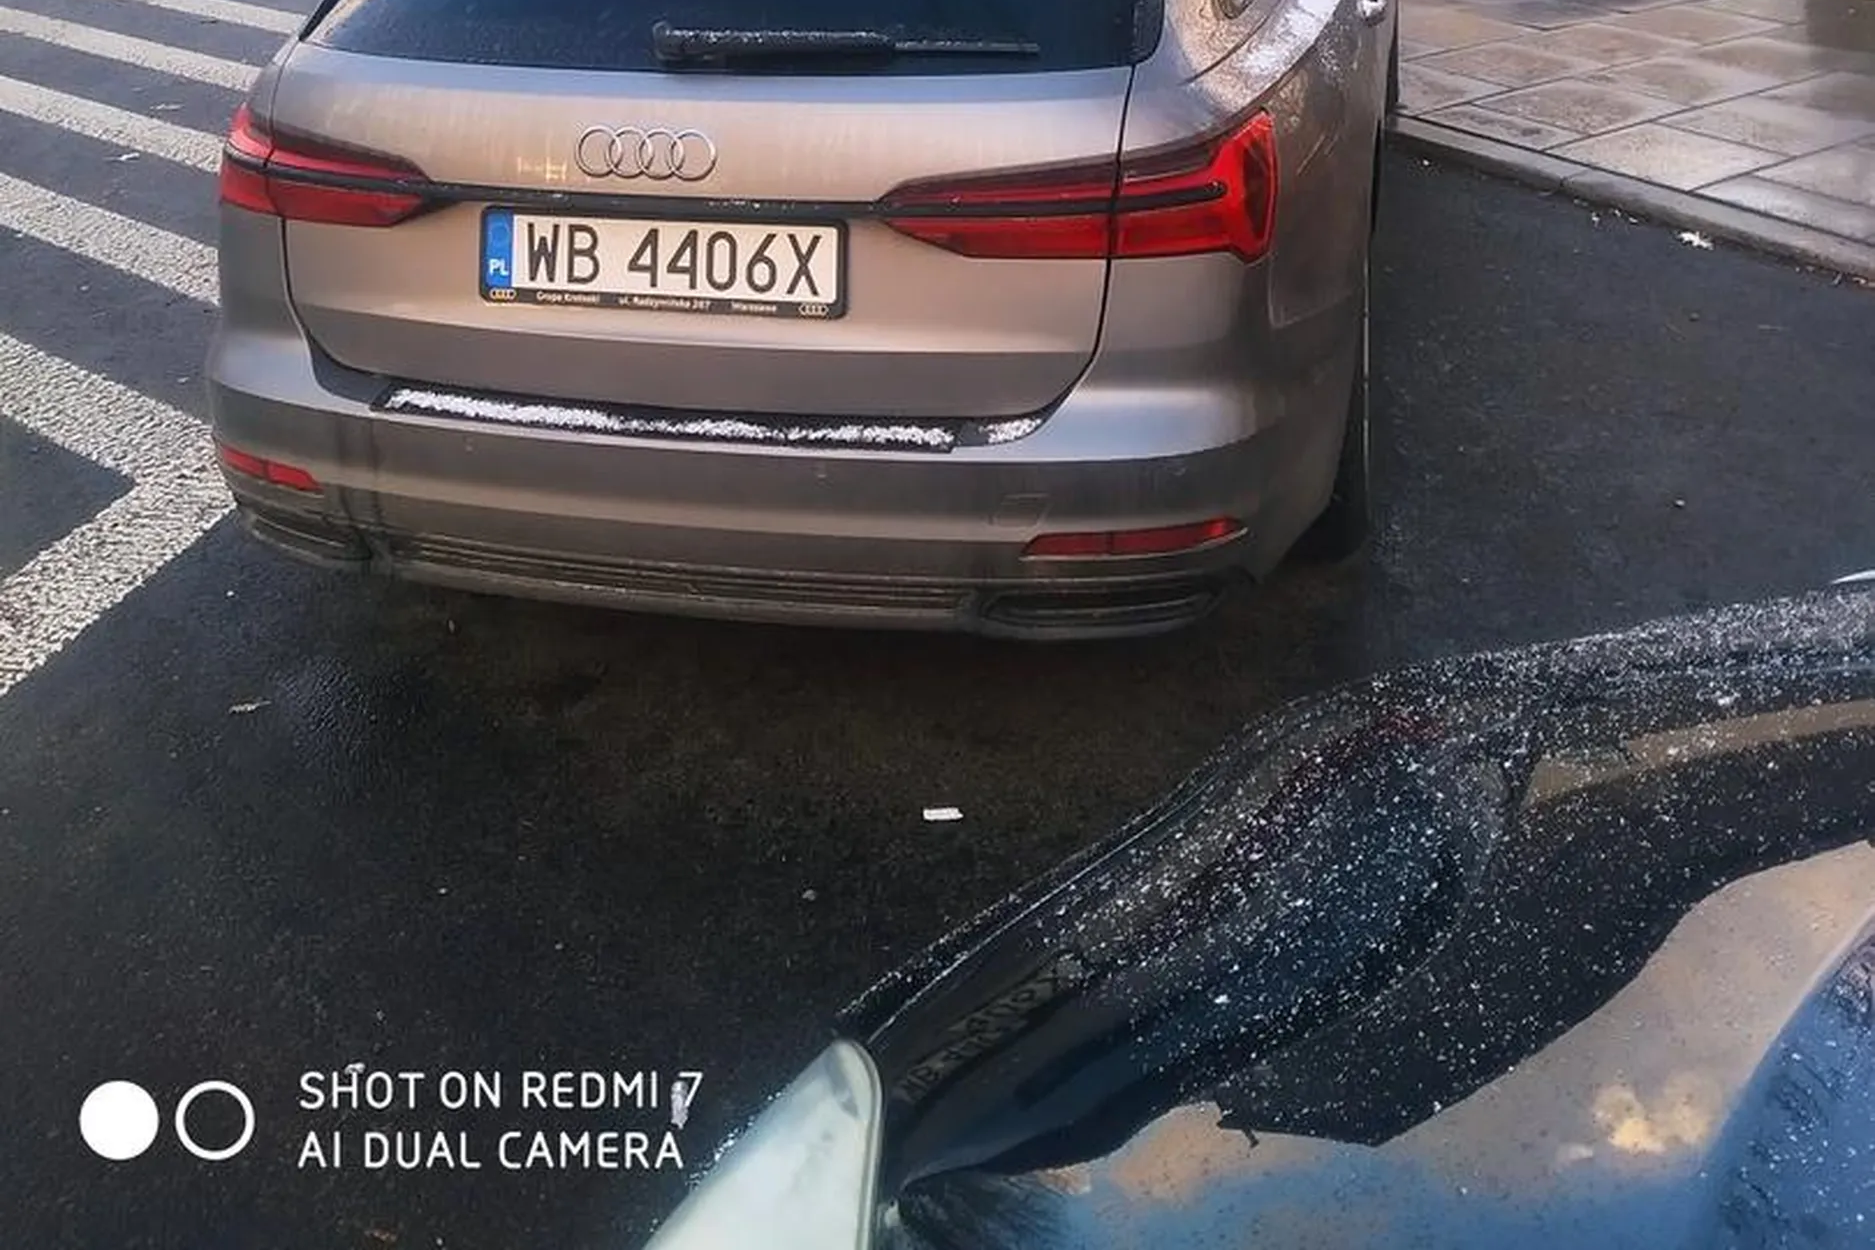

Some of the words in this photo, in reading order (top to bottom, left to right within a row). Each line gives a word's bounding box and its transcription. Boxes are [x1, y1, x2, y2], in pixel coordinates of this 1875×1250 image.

[487, 258, 510, 276] PL
[527, 221, 600, 285] WB
[627, 228, 822, 297] 4406X
